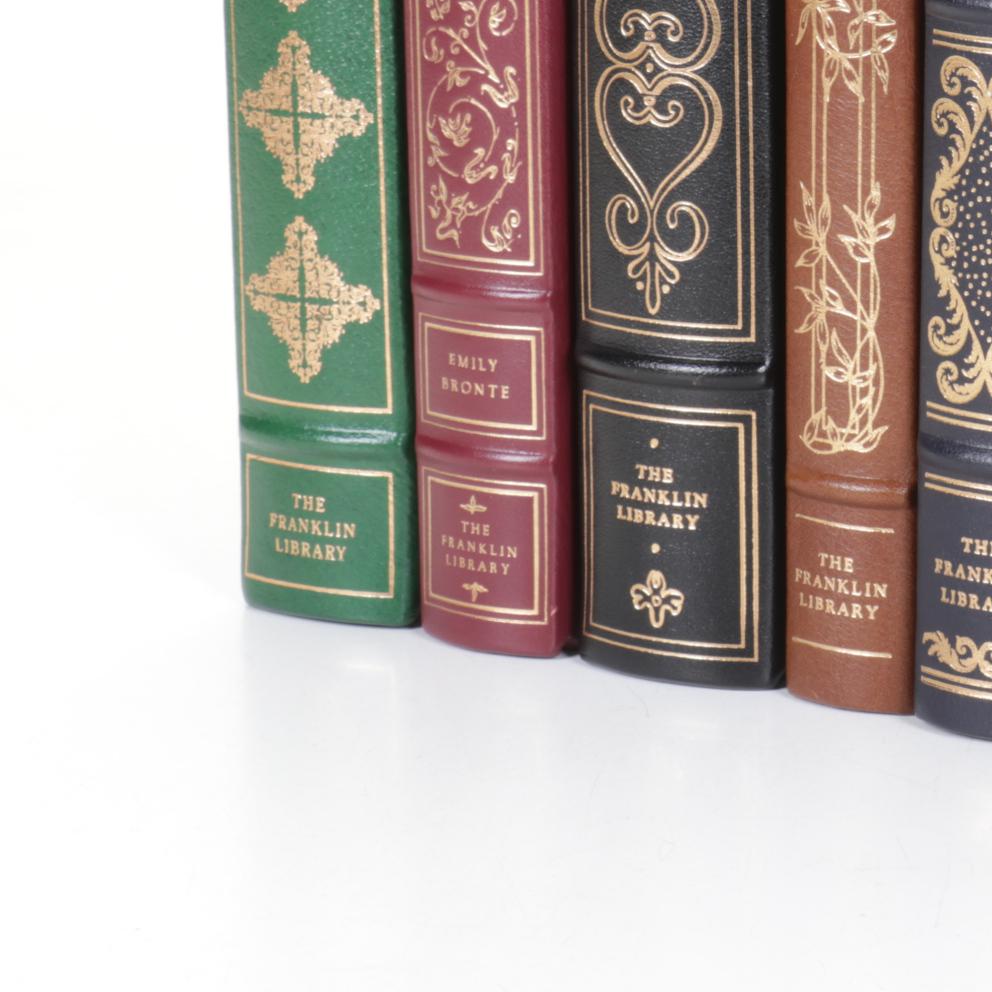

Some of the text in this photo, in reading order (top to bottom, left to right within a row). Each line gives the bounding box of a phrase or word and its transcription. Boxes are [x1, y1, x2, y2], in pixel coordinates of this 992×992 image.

[448, 353, 498, 373] EMILY
[441, 378, 510, 400] BRONTE
[636, 464, 674, 483] THE
[292, 493, 325, 512] THE
[610, 482, 708, 508] FRANKLIN
[269, 514, 356, 538] FRANKLIN
[461, 520, 490, 536] THE
[617, 505, 700, 530] LIBRARY
[275, 537, 348, 562] LIBRARY
[441, 536, 518, 558] FRANKLIN
[445, 554, 511, 575] LIBRARY
[819, 552, 854, 571] THE
[795, 569, 888, 599] FRANKLIN
[799, 593, 879, 620] LIBRARY
